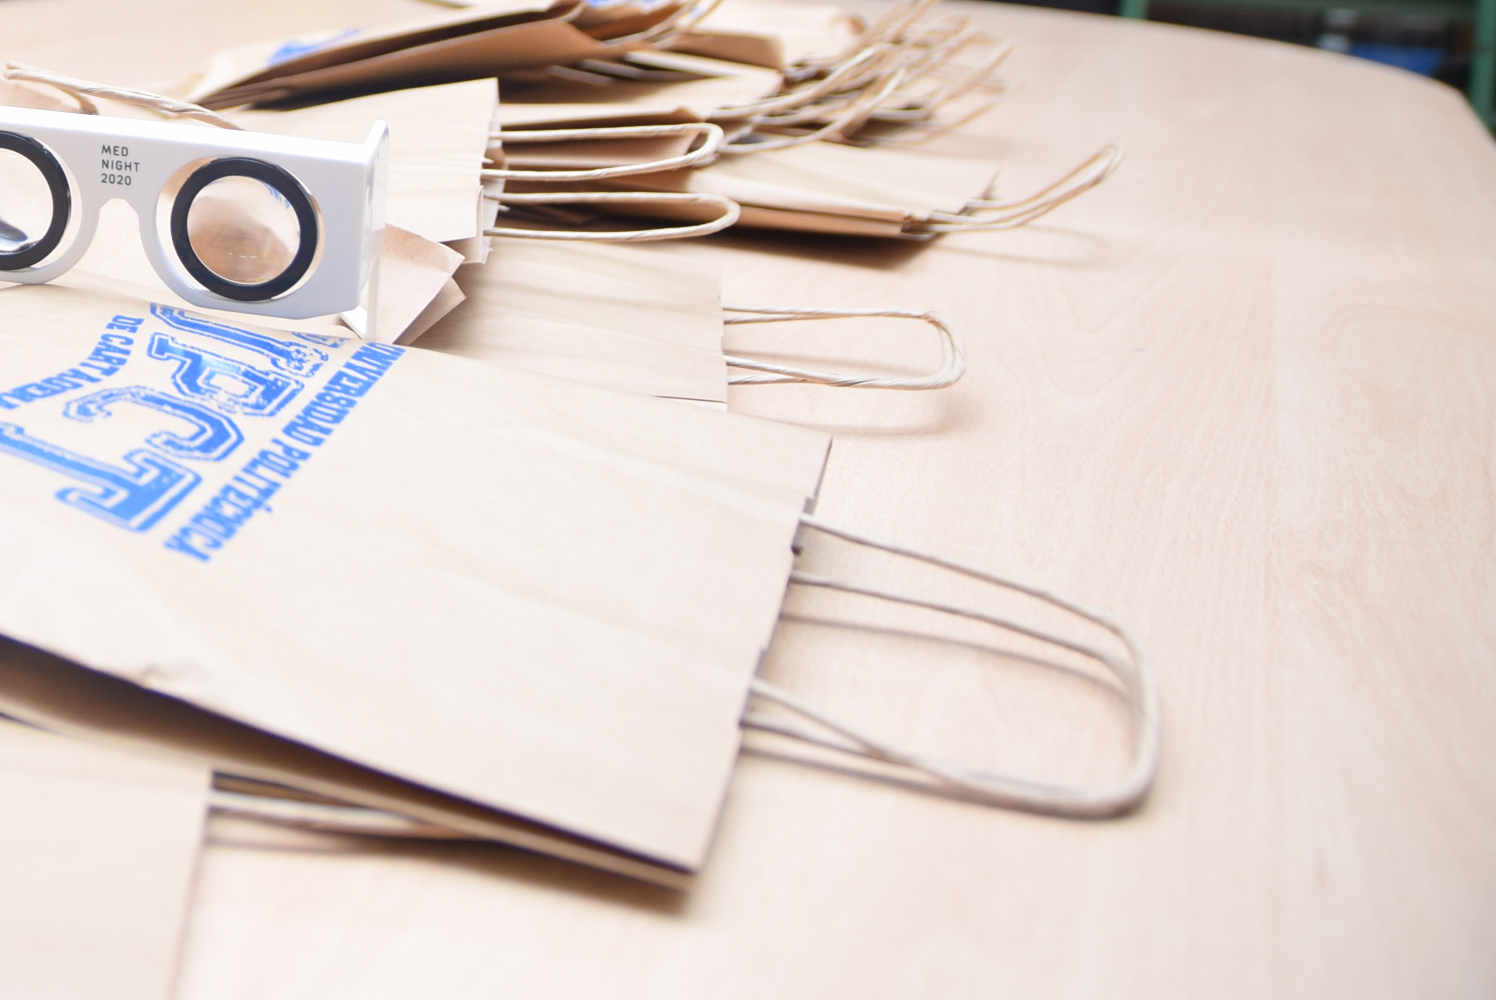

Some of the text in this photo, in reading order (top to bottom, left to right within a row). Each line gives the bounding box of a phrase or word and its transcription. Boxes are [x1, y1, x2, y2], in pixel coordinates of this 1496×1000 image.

[101, 144, 129, 157] MED
[101, 159, 140, 172] NIGHT
[101, 173, 132, 186] 2020
[106, 315, 145, 334] DE
[163, 341, 406, 562] UNIVERSIDAD POLITÉCNICA
